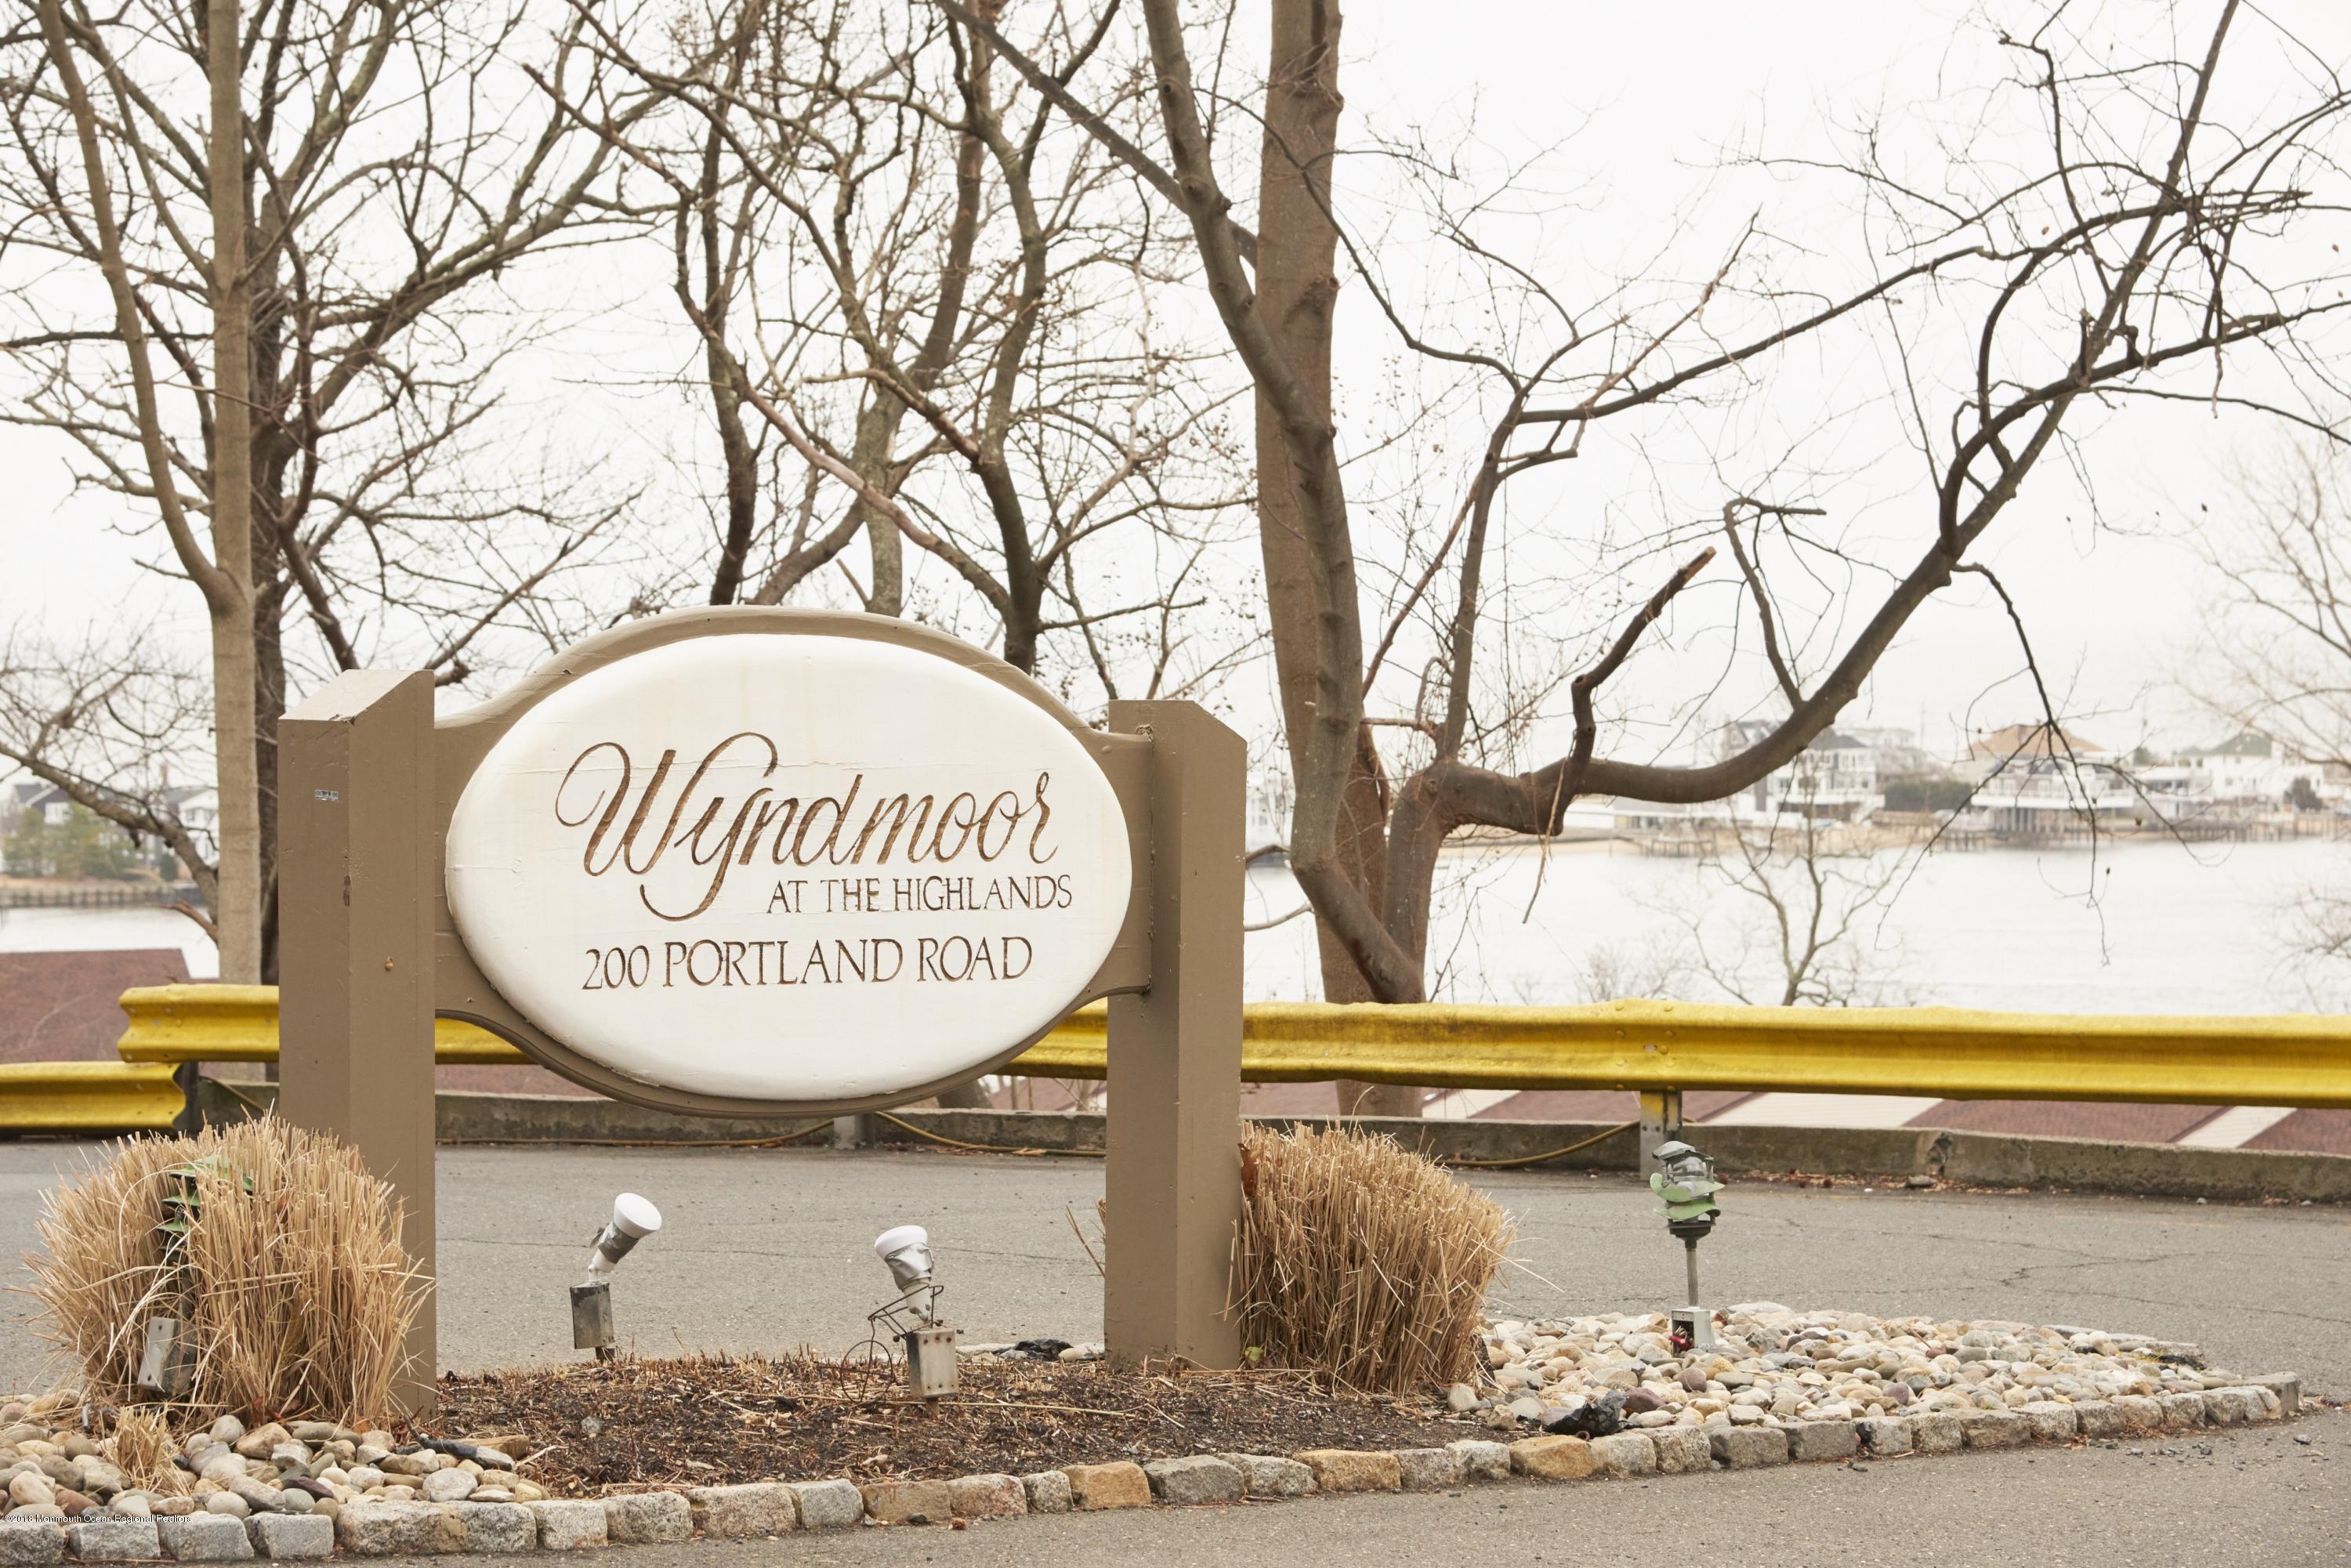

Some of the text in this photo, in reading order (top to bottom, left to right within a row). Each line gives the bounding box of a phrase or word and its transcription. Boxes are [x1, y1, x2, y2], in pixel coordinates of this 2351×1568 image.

[554, 731, 1060, 922] Wyndmoor
[766, 874, 1073, 914] AT THE HIGHLANDS
[581, 935, 1033, 990] 200 PORTLAND ROAD
